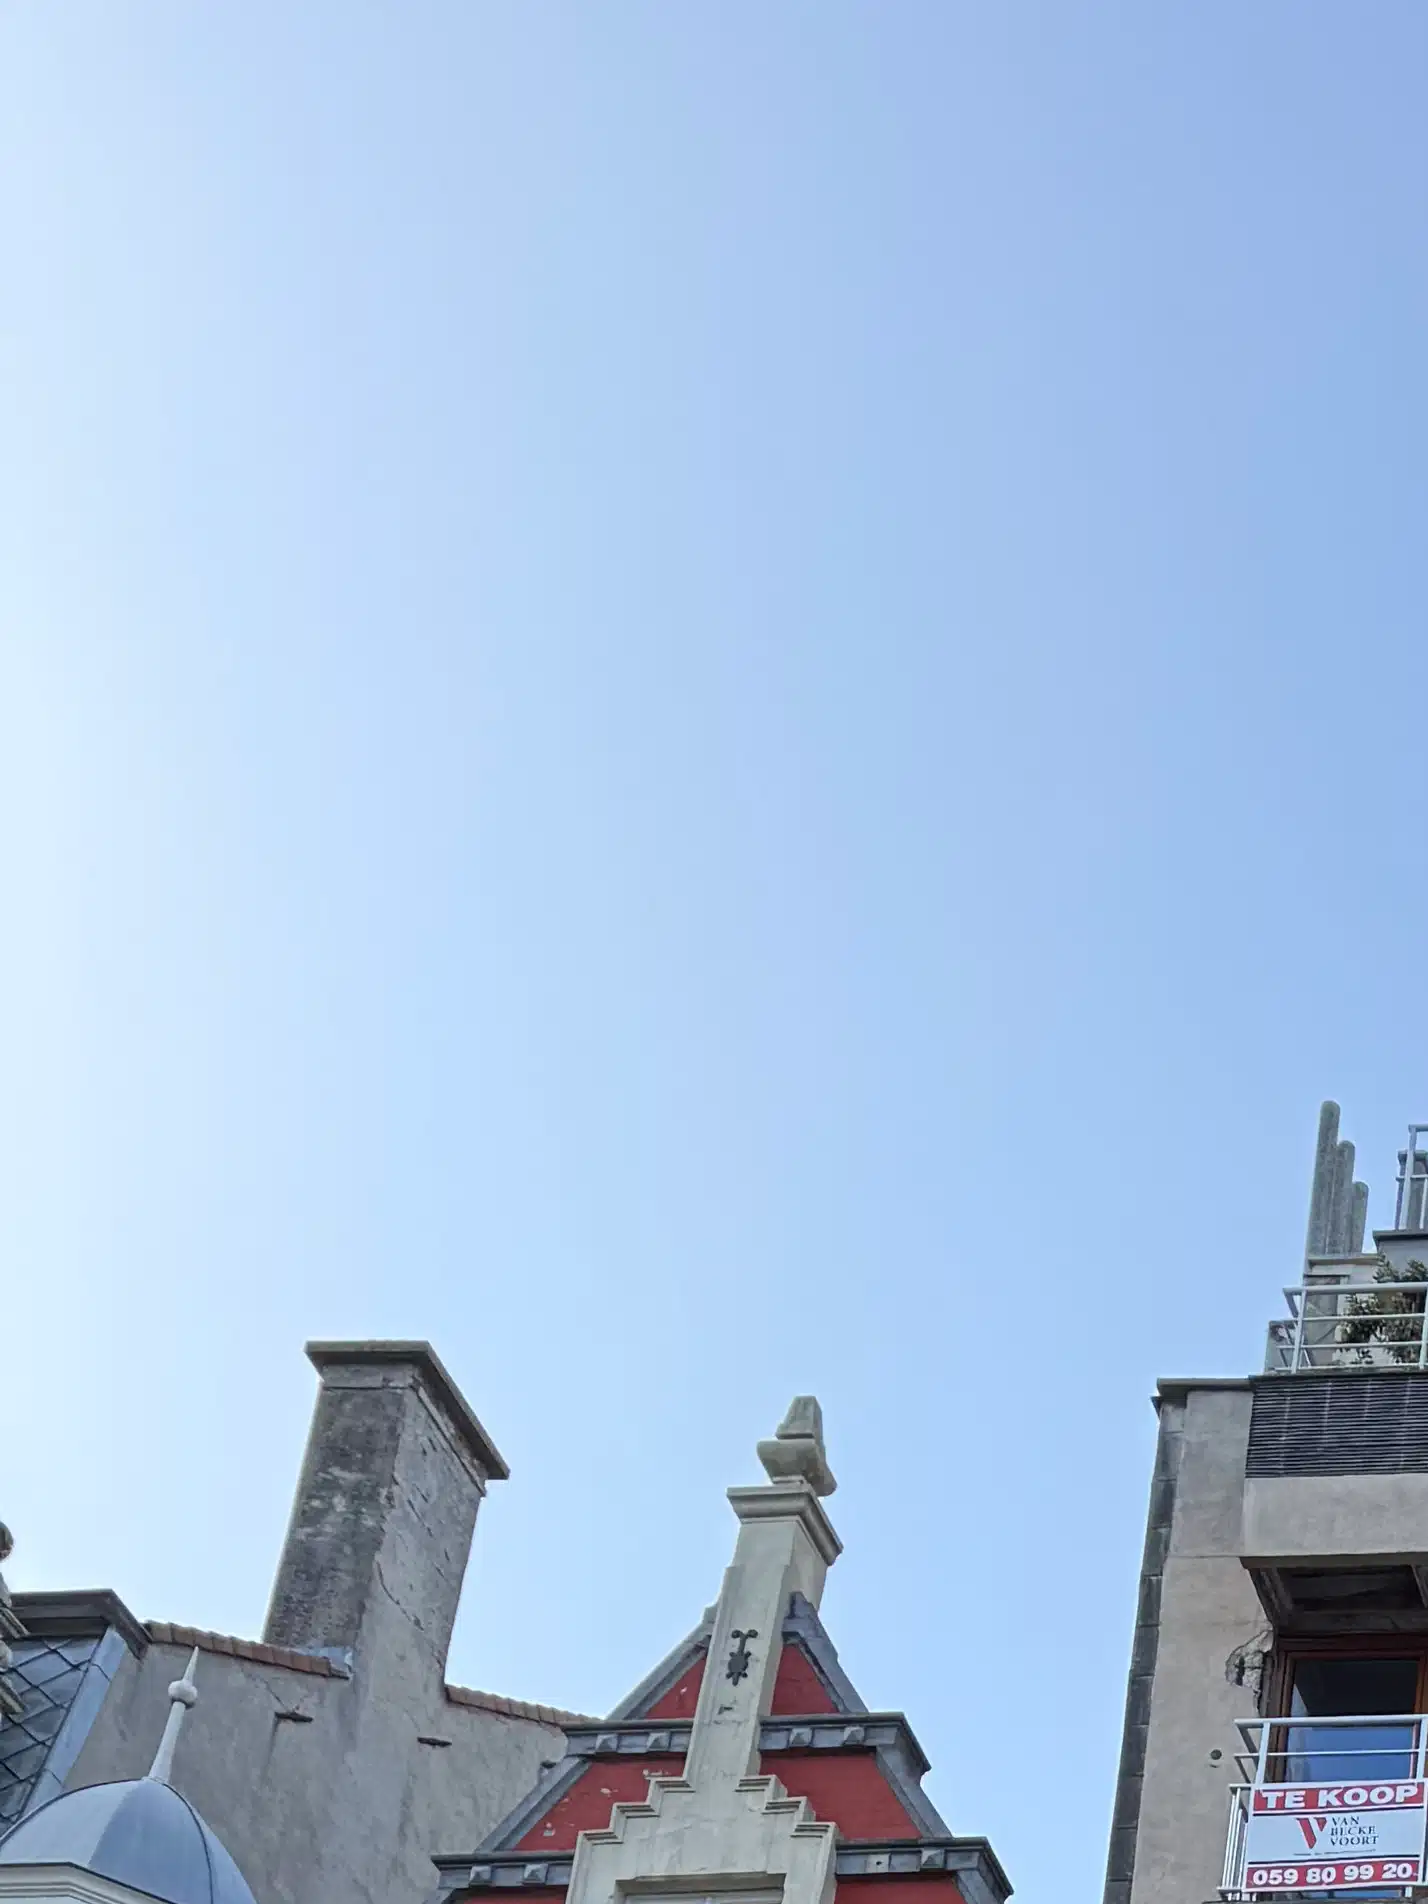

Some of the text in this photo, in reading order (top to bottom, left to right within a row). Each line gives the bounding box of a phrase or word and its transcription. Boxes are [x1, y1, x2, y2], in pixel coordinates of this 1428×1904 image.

[1261, 1785, 1419, 1809] TE KOOP
[1331, 1816, 1360, 1826] VAN
[1330, 1835, 1379, 1846] VOORT
[1252, 1862, 1413, 1886] 059 80 99 20
